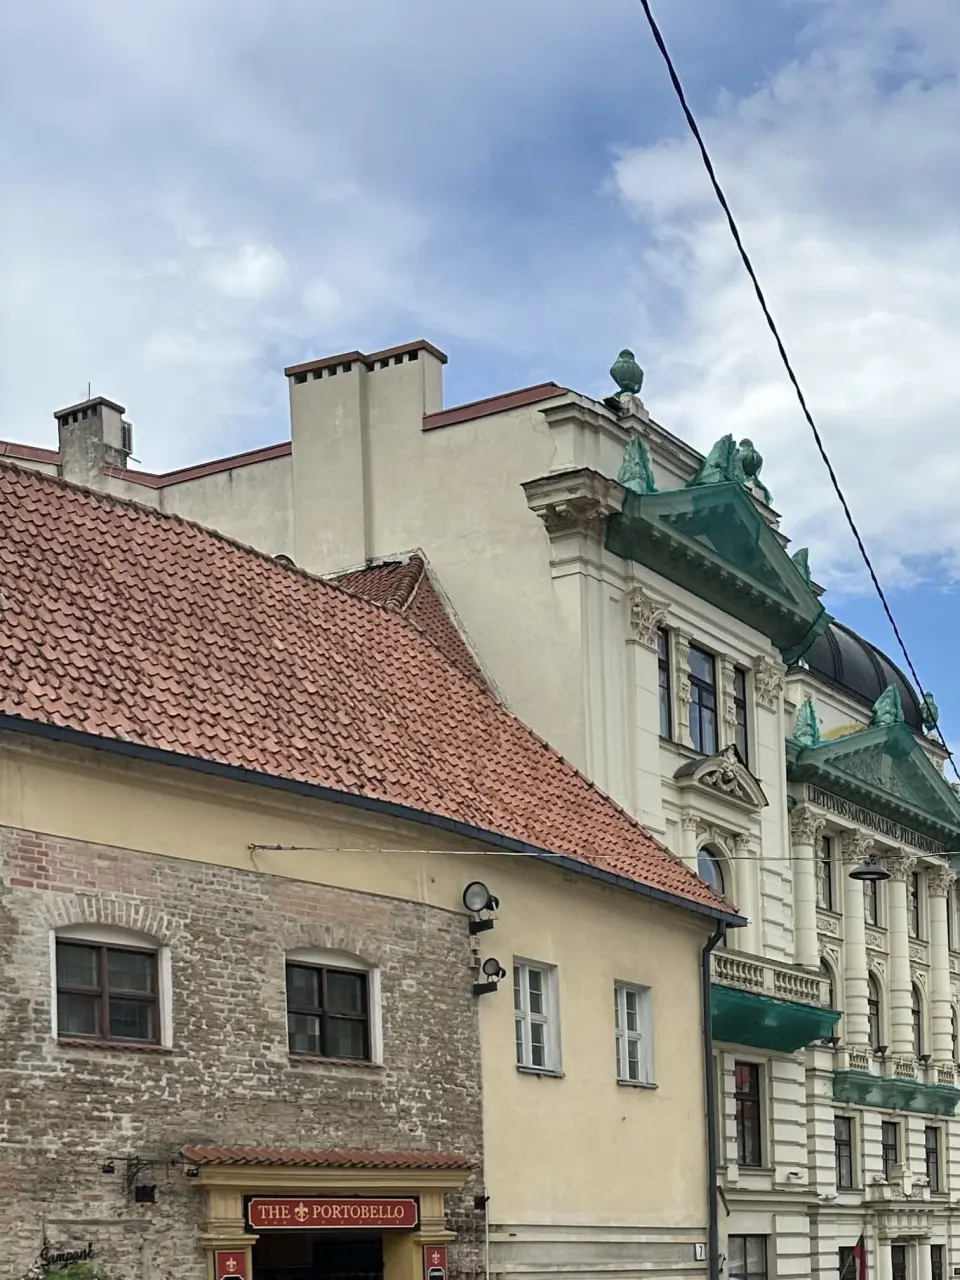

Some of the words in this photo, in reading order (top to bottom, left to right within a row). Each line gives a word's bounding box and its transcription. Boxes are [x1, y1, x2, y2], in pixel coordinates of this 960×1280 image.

[807, 784, 848, 817] LIETUVOS
[257, 1204, 291, 1219] THE
[312, 1204, 405, 1219] PORTOBELLO
